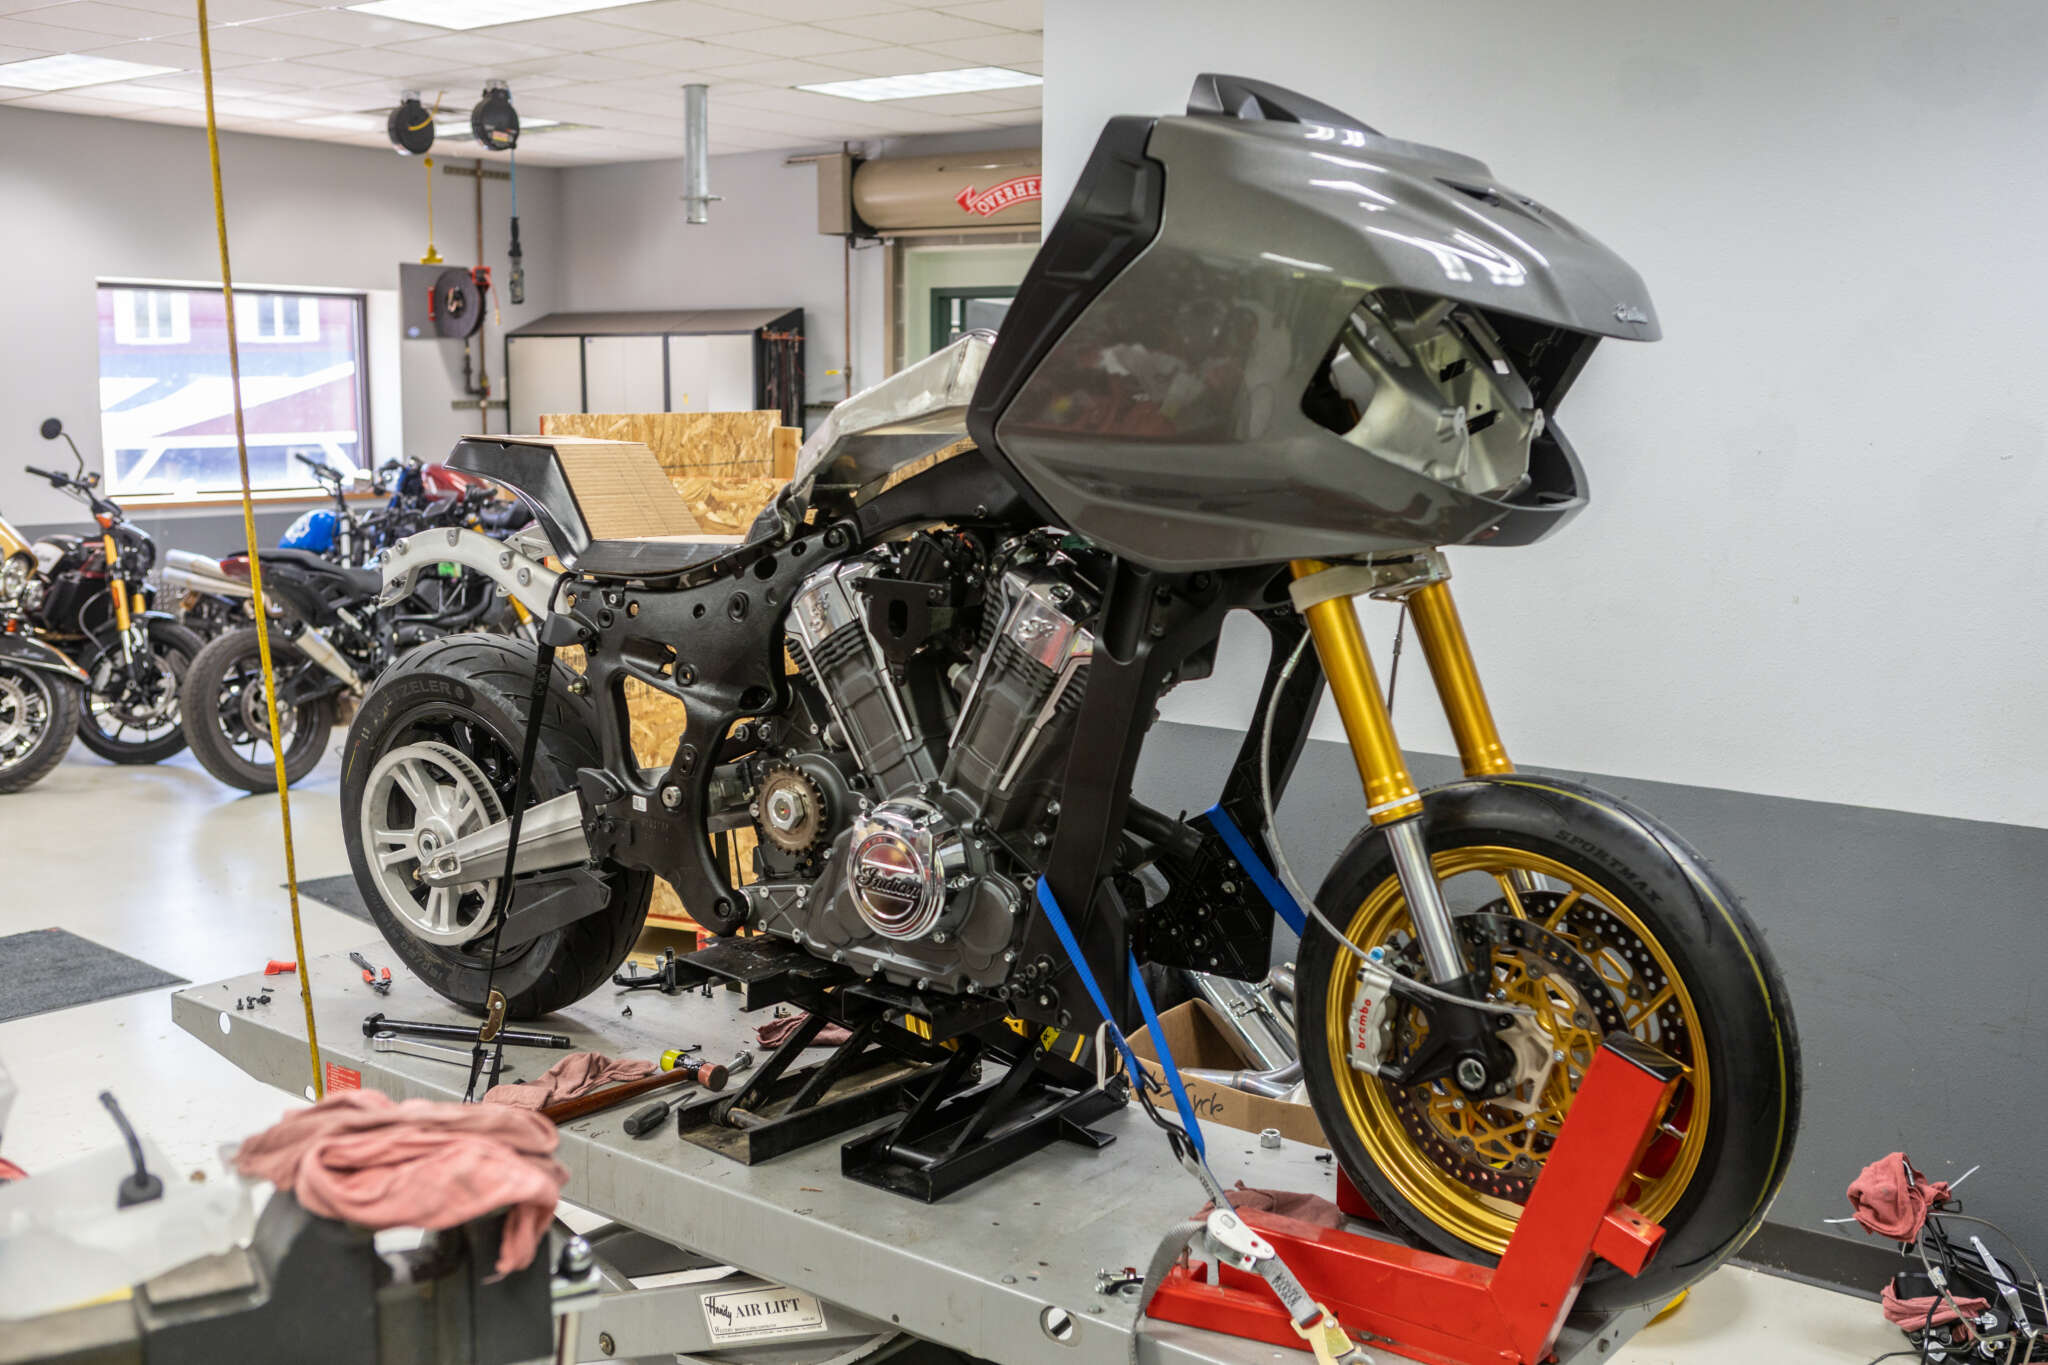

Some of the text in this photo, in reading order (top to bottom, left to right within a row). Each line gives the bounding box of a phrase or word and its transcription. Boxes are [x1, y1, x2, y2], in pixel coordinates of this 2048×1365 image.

[976, 180, 1042, 213] OVERHE
[855, 866, 922, 900] Indian
[1555, 829, 1663, 903] SPORTMAX
[1355, 998, 1372, 1050] brembo
[704, 1295, 800, 1326] Handy AIR LIFT
